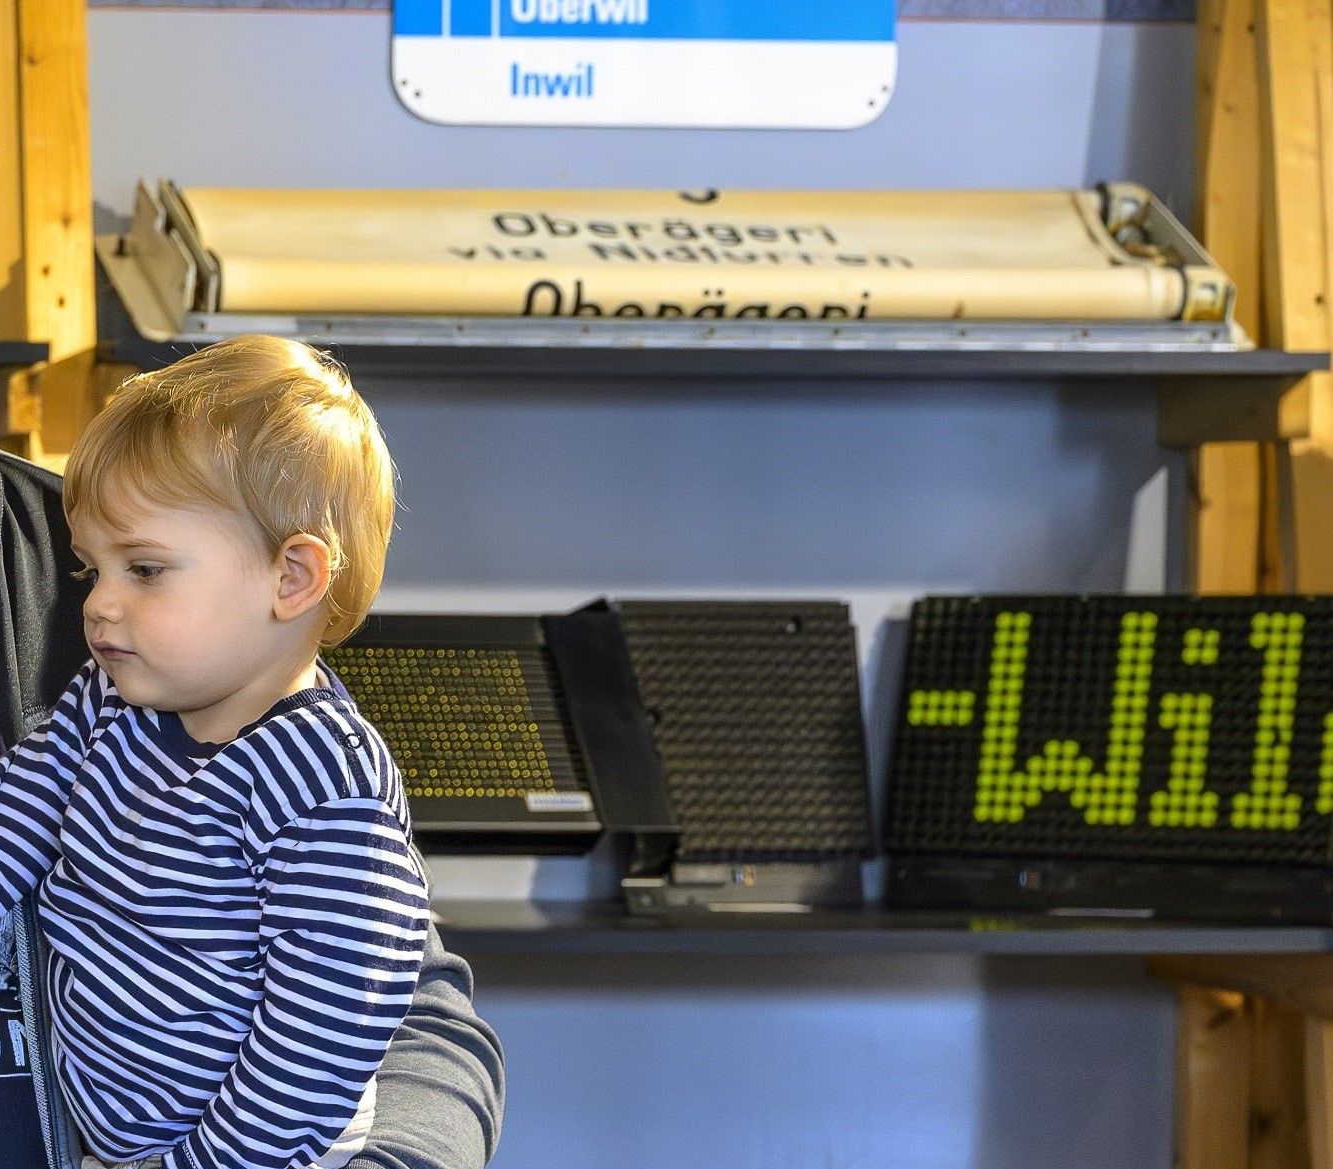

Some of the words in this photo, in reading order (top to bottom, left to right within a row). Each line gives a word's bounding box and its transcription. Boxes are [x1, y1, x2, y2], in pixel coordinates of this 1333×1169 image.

[510, 0, 649, 24] Oberwil
[510, 62, 595, 97] Inwil
[491, 211, 838, 246] Oberägeri
